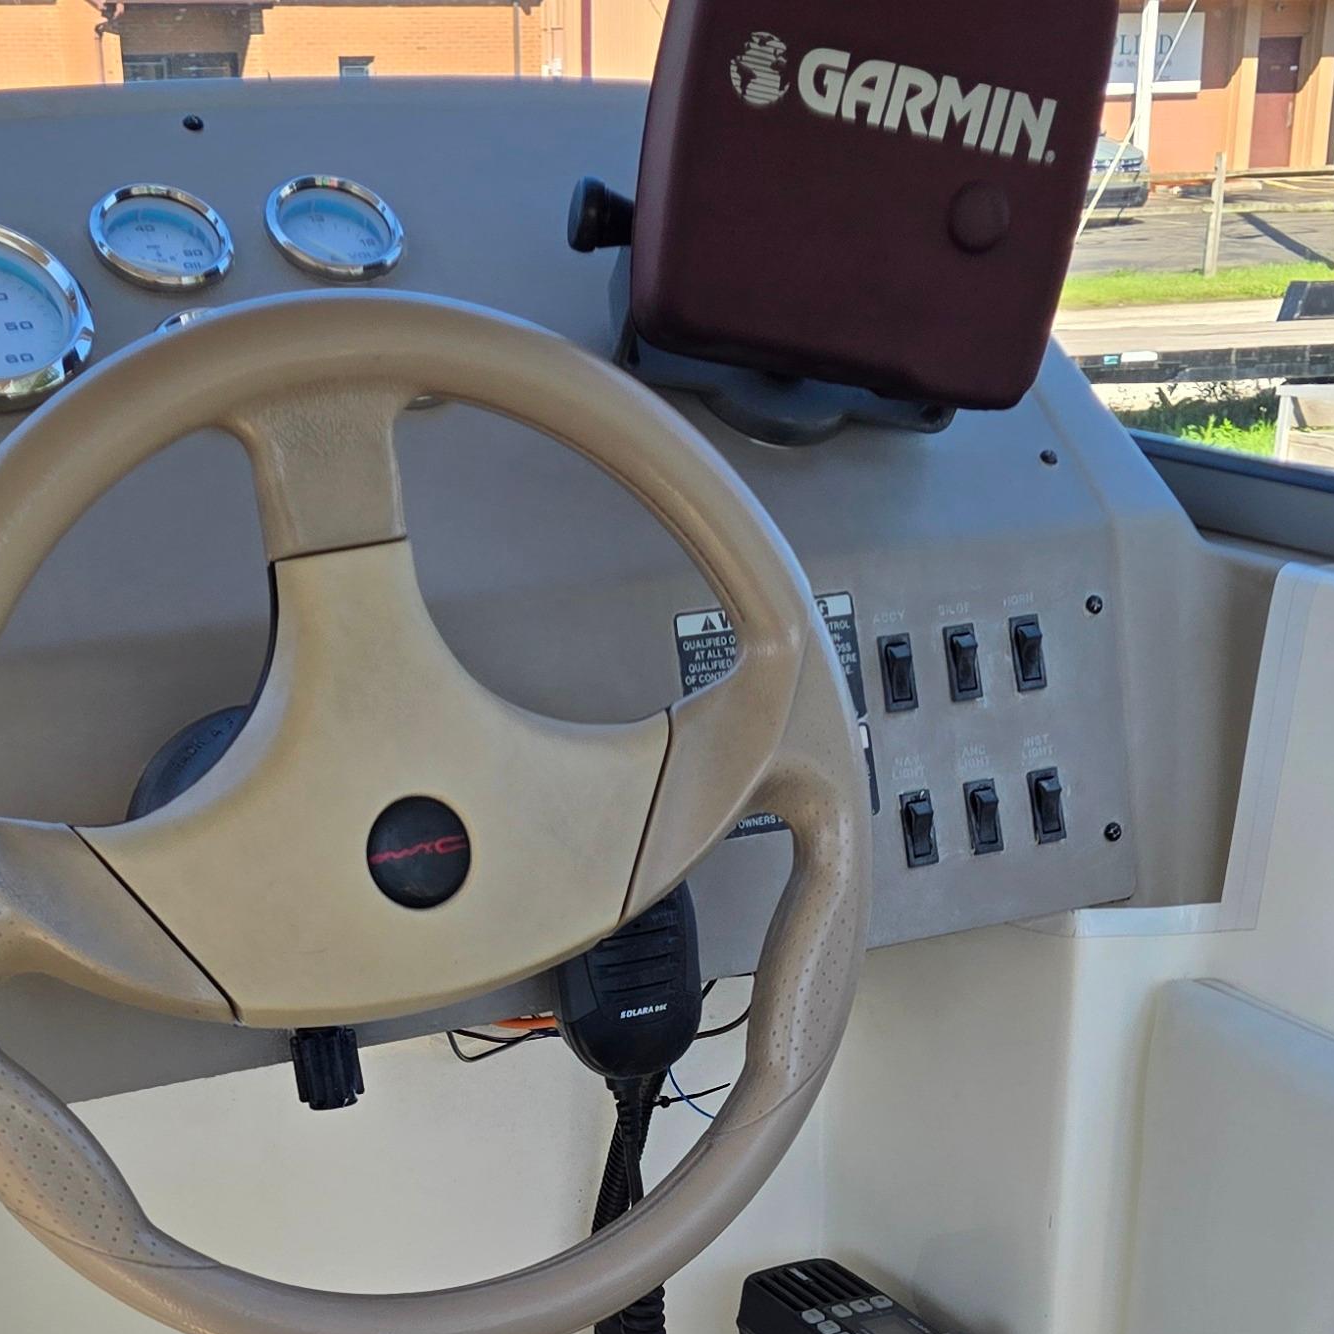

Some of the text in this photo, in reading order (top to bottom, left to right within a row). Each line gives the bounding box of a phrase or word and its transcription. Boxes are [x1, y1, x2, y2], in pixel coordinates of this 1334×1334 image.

[798, 47, 1058, 163] GARMIN
[4, 321, 34, 331] 50
[6, 353, 34, 364] 60
[682, 636, 728, 651] QUALIFIED
[694, 648, 723, 660] AT ALL
[688, 659, 733, 674] QUALIFIED
[685, 674, 697, 686] OF
[738, 814, 776, 830] OWNERS
[620, 1005, 654, 1020] SOLARA
